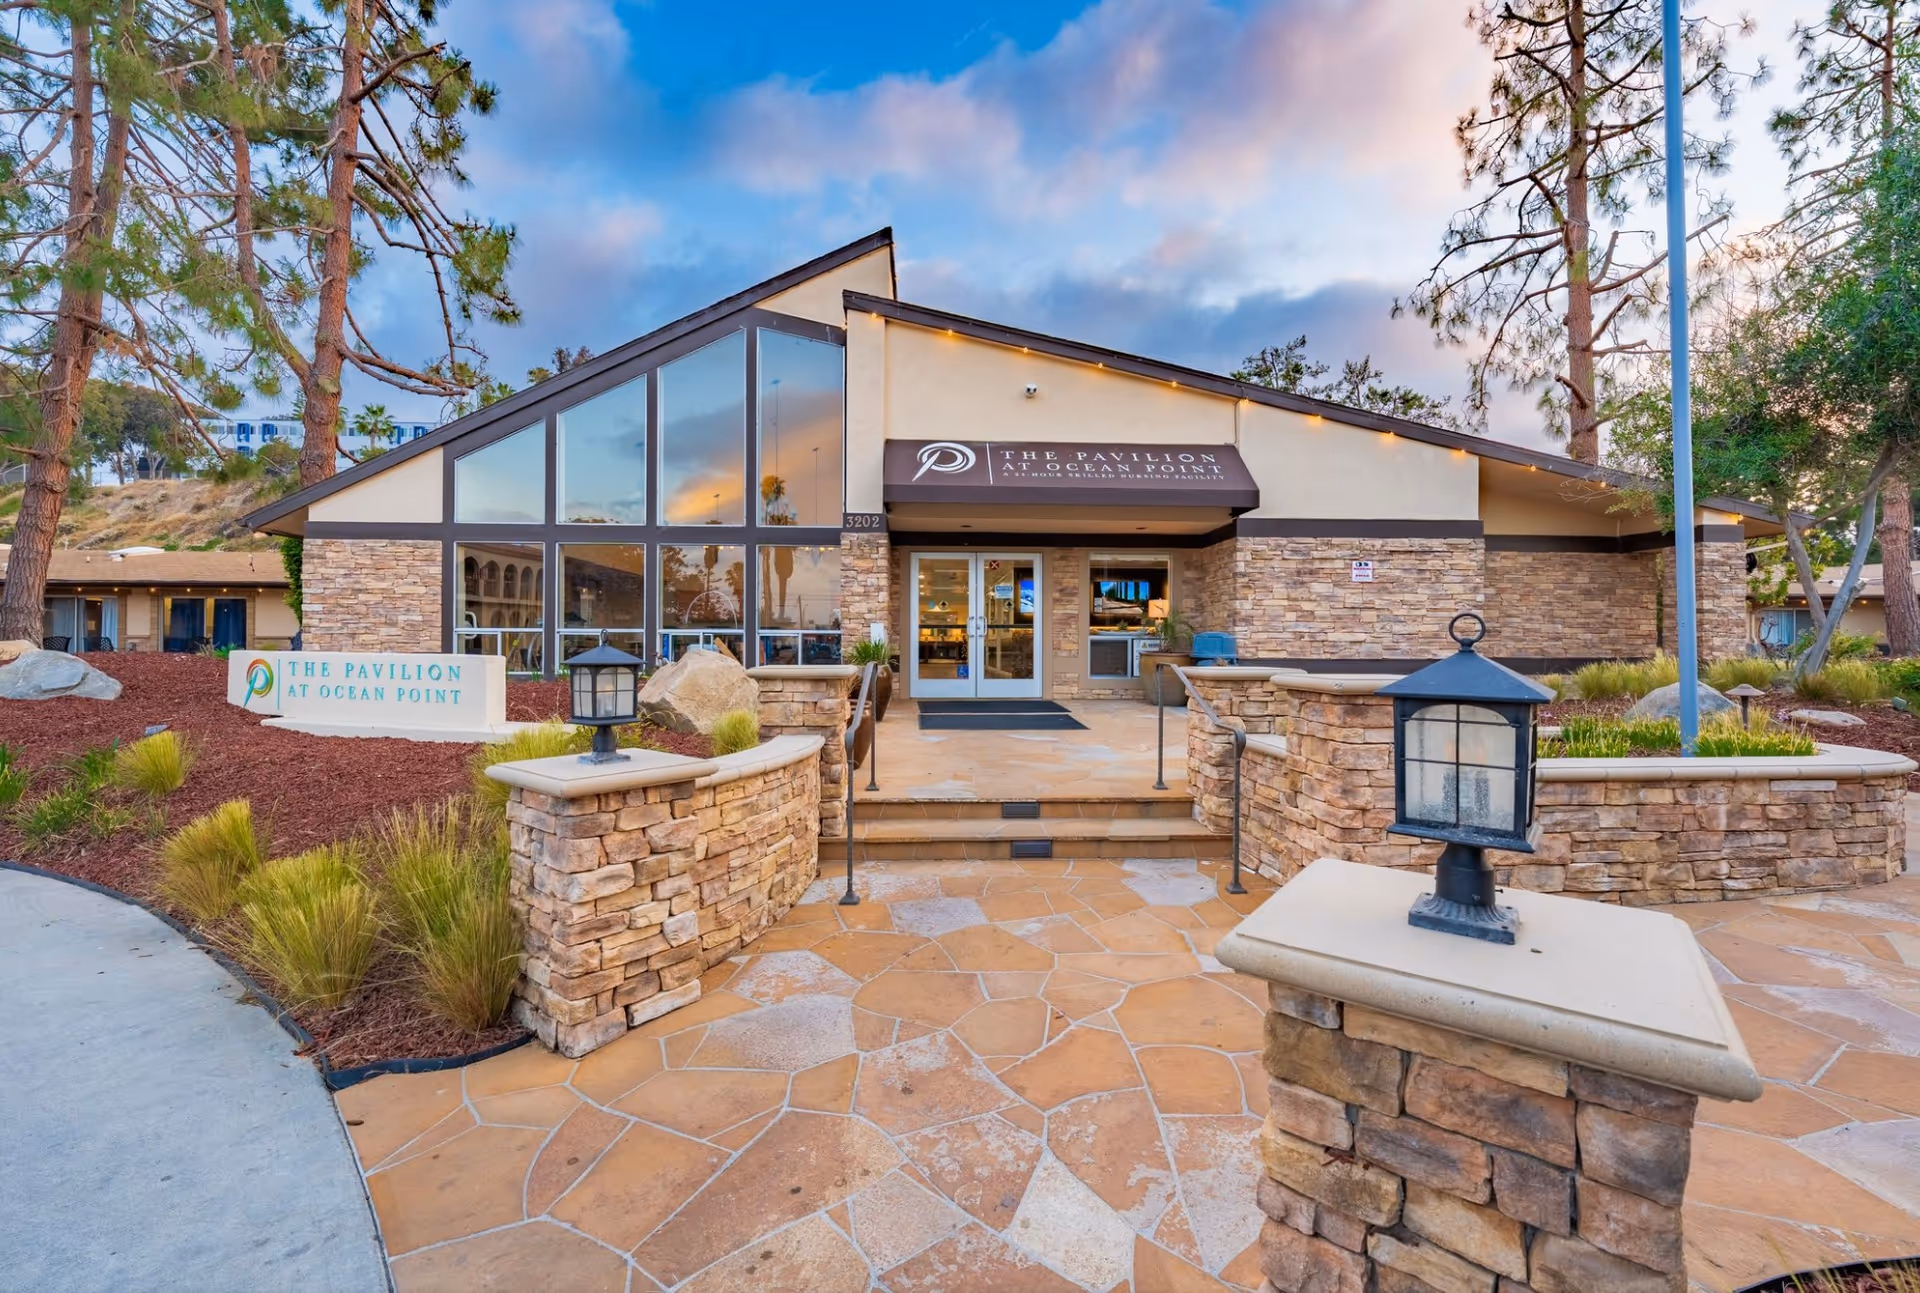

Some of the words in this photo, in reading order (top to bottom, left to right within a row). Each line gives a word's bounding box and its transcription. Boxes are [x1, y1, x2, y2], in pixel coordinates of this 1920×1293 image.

[1000, 450, 1058, 460] THE
[1076, 451, 1216, 463] PAVILION
[1002, 462, 1031, 471] AT
[1046, 462, 1130, 472] OCEAN
[1145, 464, 1222, 474] POINT
[846, 515, 880, 528] 3202
[288, 661, 330, 678] THE
[345, 662, 462, 682] PAVILION
[288, 683, 309, 698] AT
[319, 684, 385, 701] OCEAN
[396, 687, 462, 705] POINT
